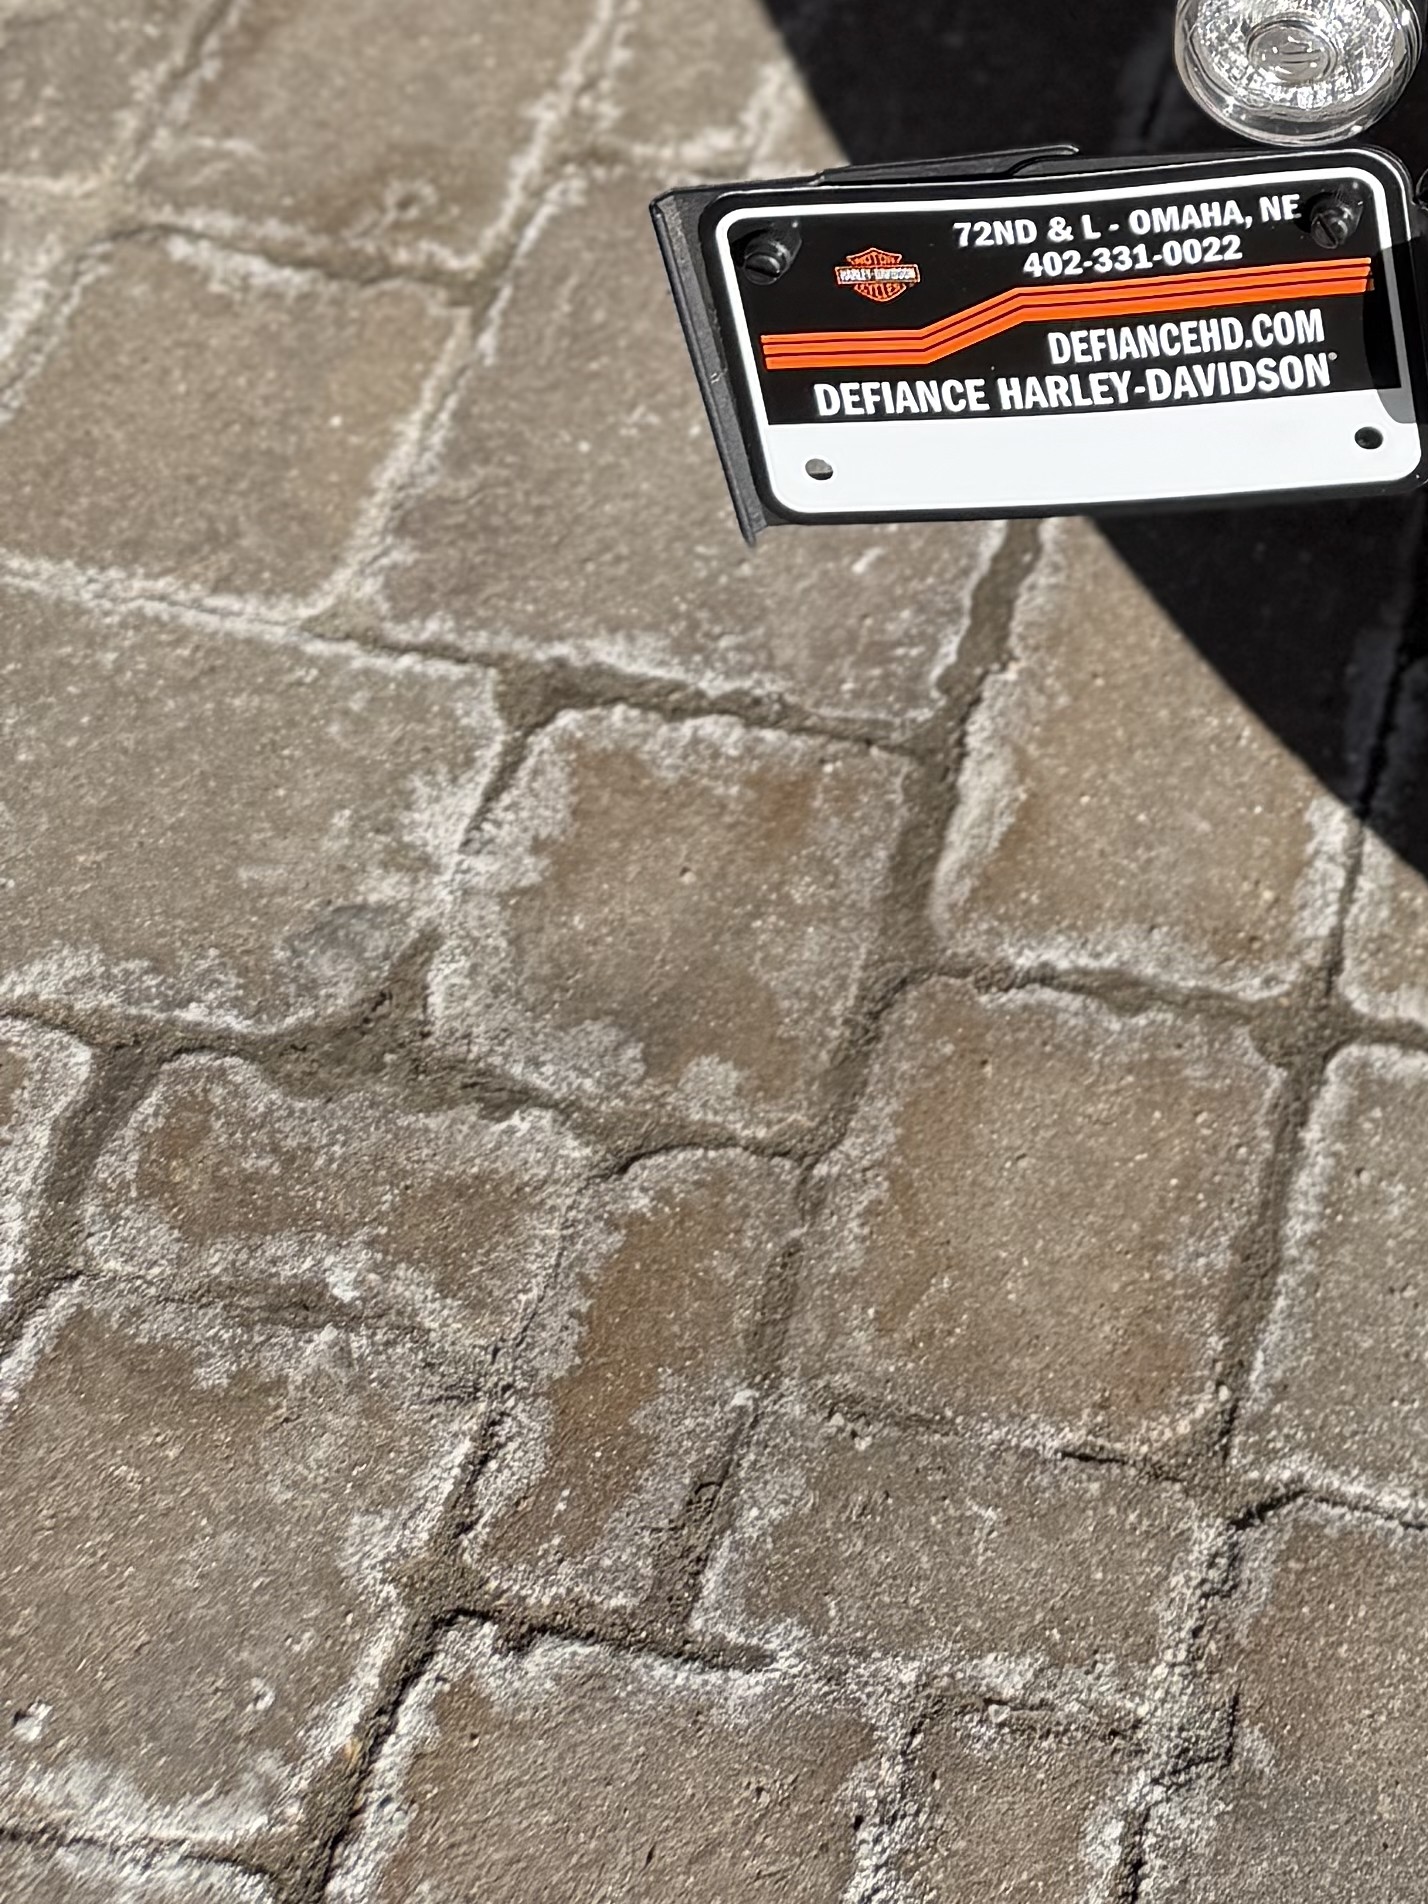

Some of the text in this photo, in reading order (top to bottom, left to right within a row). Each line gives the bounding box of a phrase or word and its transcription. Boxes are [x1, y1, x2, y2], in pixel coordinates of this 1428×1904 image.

[953, 194, 1303, 248] 72ND & L - OMAHA, NE
[1023, 235, 1244, 278] 402-331-0022
[1047, 308, 1325, 365] DEFIANCEHD.COM
[813, 378, 990, 417] DEFIANCE
